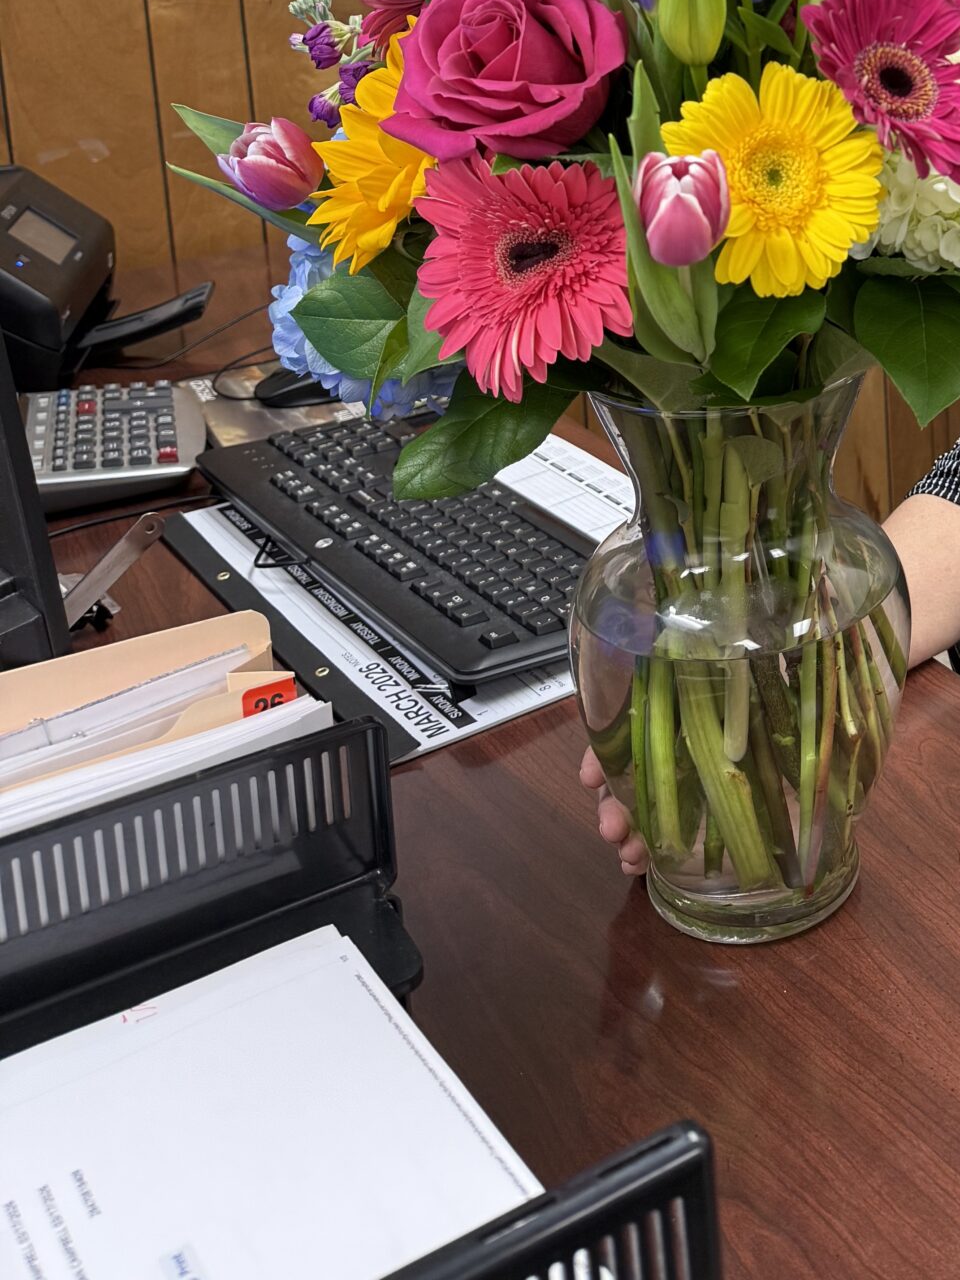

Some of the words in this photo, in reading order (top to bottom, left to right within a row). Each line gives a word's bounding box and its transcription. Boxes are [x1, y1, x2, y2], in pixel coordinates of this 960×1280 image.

[311, 587, 349, 618] WEDNESDAY
[350, 621, 381, 645] TUESDAY
[341, 651, 361, 668] NOTES
[388, 656, 421, 681] MONDAY
[358, 662, 402, 691] 2026
[539, 684, 551, 692] 8
[385, 689, 450, 738] MARCH
[430, 694, 462, 719] SUNDAY
